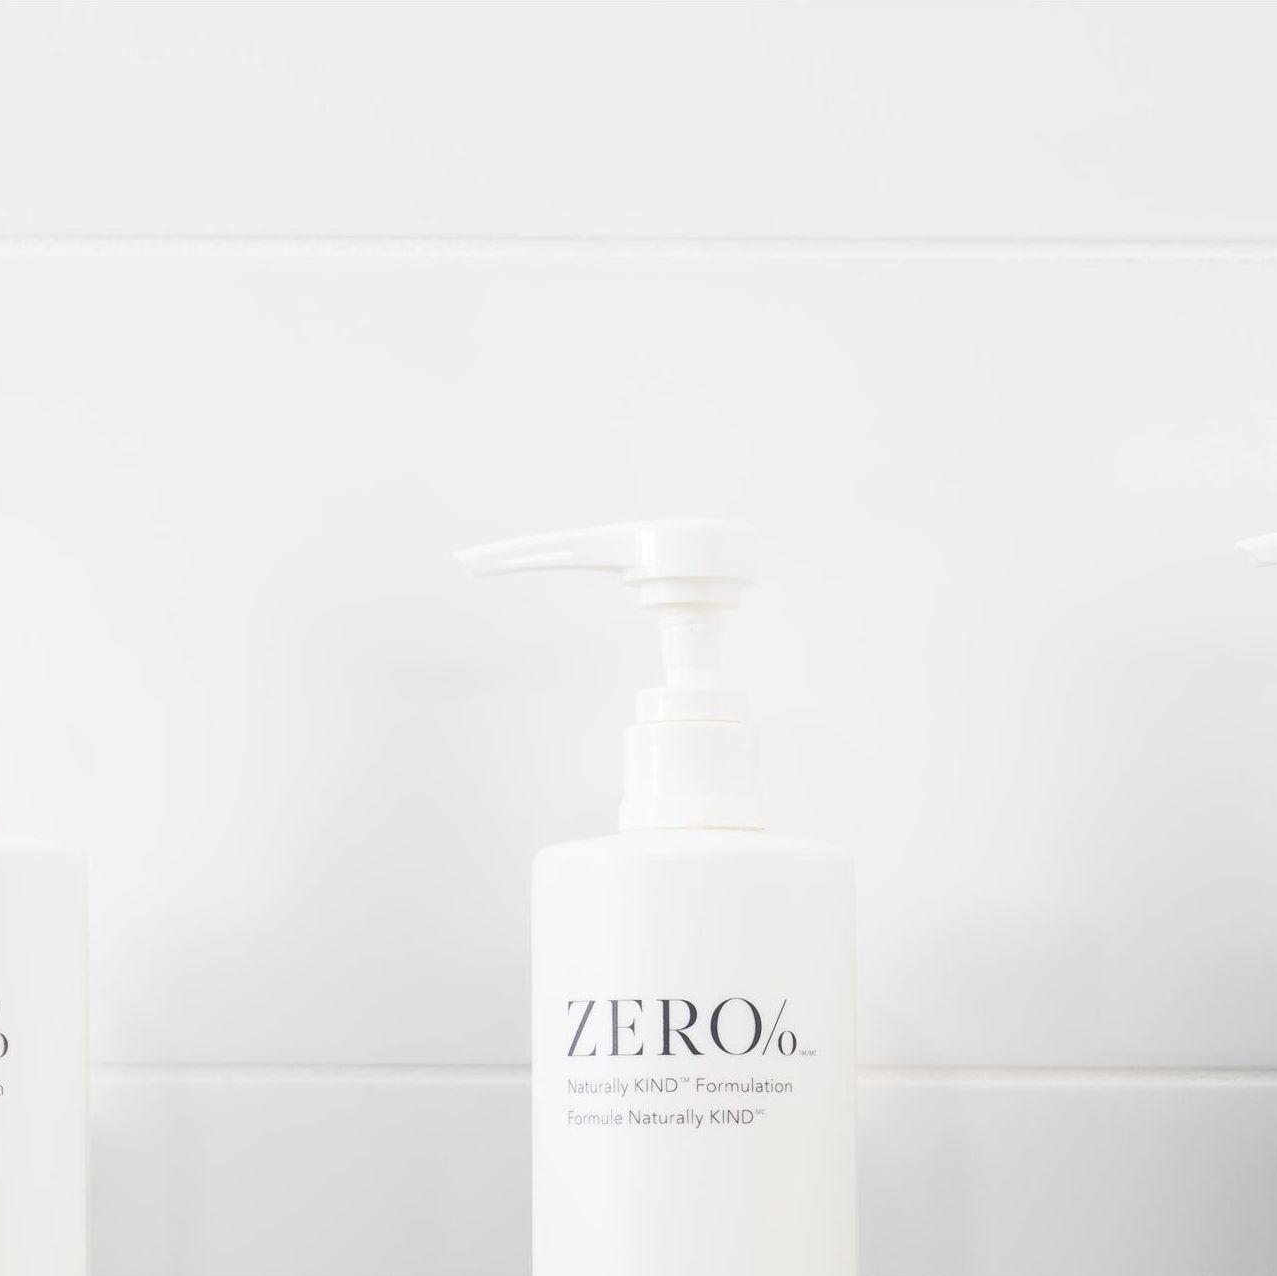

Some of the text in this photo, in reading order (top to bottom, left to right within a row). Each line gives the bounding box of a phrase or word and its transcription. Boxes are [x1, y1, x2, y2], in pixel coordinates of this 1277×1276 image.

[568, 997, 797, 1056] ZERO%
[568, 1078, 628, 1097] Naturally
[696, 1078, 792, 1093] Formulation
[568, 1110, 623, 1125] Formule
[629, 1109, 704, 1128] Naturally
